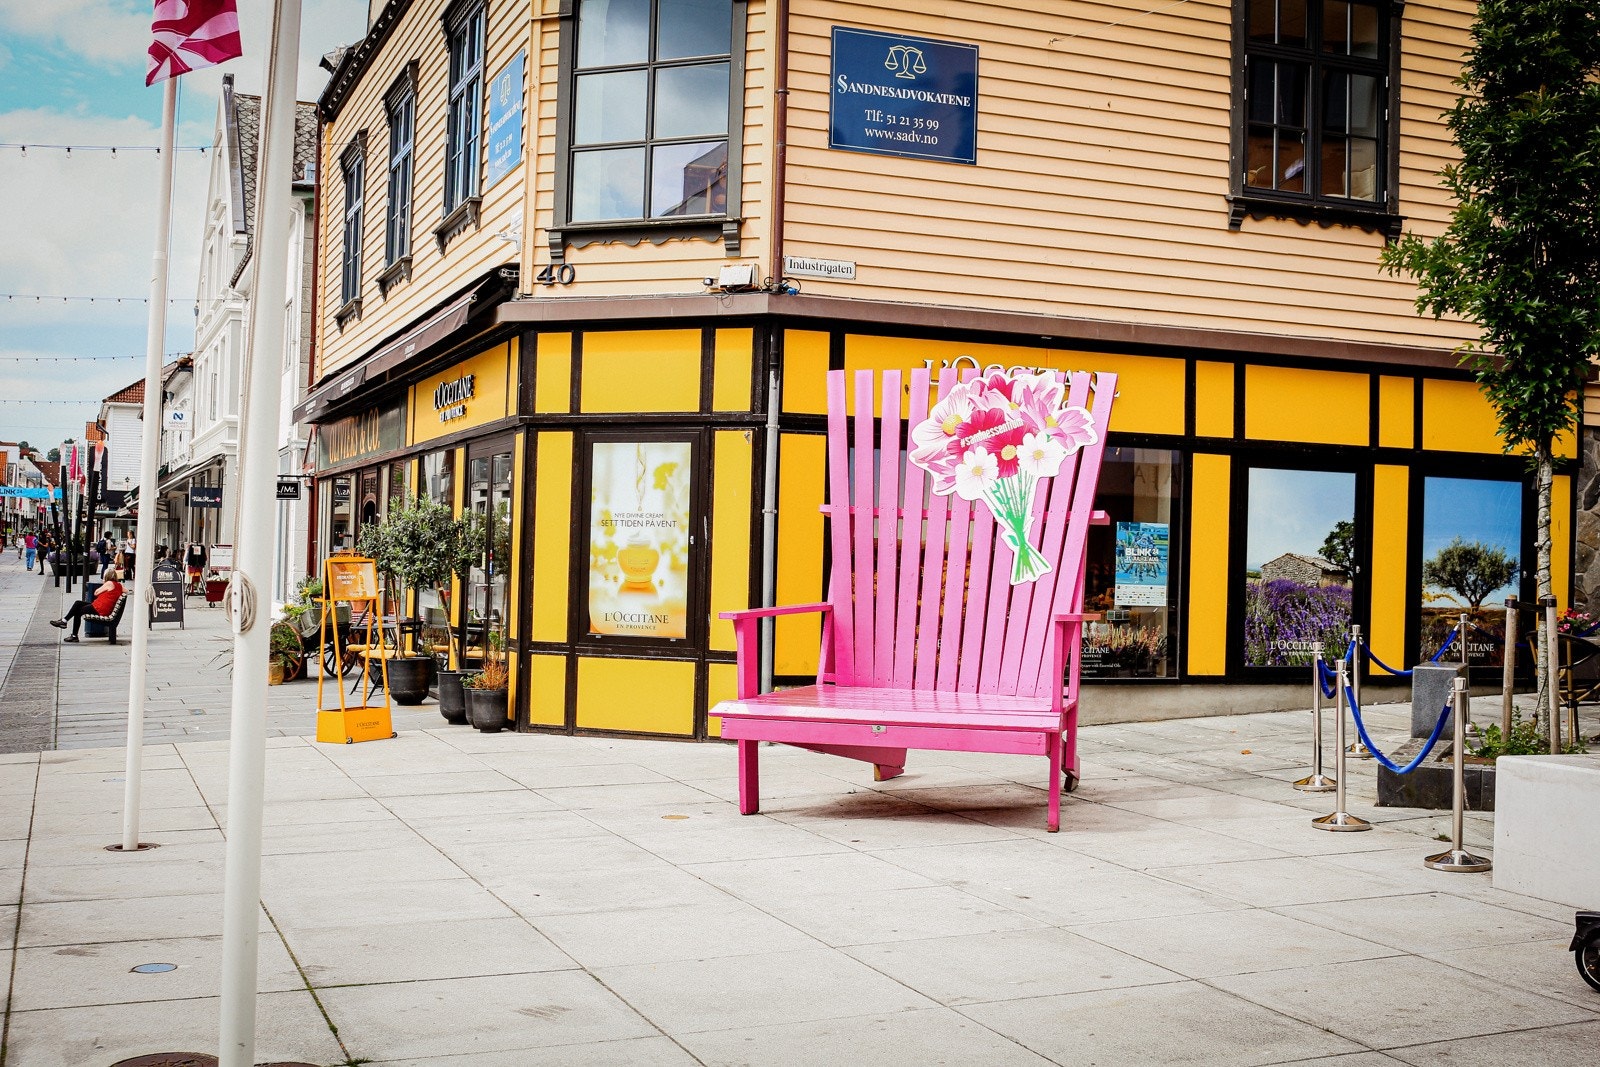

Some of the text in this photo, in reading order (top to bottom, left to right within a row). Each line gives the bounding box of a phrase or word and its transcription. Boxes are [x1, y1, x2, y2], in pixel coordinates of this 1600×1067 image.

[864, 109, 939, 131] Tlf: 51 21 35 99
[864, 127, 938, 145] www.sadv.no
[537, 264, 576, 285] 40
[789, 259, 852, 275] Industrigaten
[601, 519, 619, 527] SETT
[620, 520, 644, 528] TIDEN
[656, 520, 678, 528] VENT
[1125, 547, 1152, 557] BLINK
[604, 611, 669, 624] L'OCCITANE
